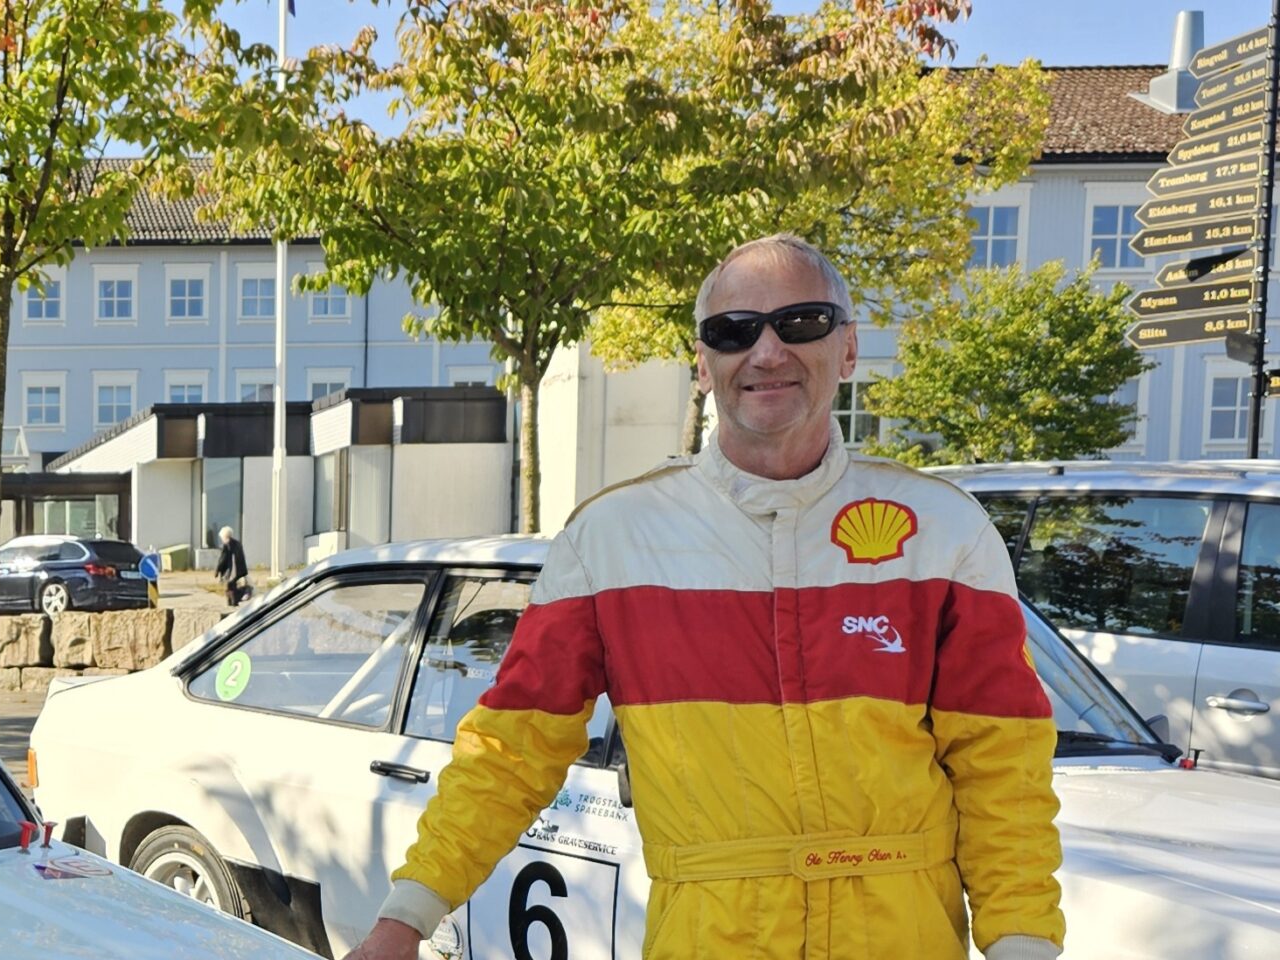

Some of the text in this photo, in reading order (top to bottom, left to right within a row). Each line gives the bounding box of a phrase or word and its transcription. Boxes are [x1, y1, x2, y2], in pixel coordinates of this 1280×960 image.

[1254, 36, 1268, 48] km
[1252, 67, 1266, 79] km
[1250, 100, 1264, 110] km
[1246, 131, 1261, 141] km
[1215, 164, 1238, 177] 17,7
[1239, 162, 1258, 173] km
[1235, 193, 1255, 205] km
[1232, 223, 1253, 236] km
[1234, 257, 1253, 269] km
[1229, 287, 1250, 298] km
[1226, 318, 1248, 329] km
[841, 614, 890, 634] SNC
[224, 660, 242, 688] 2
